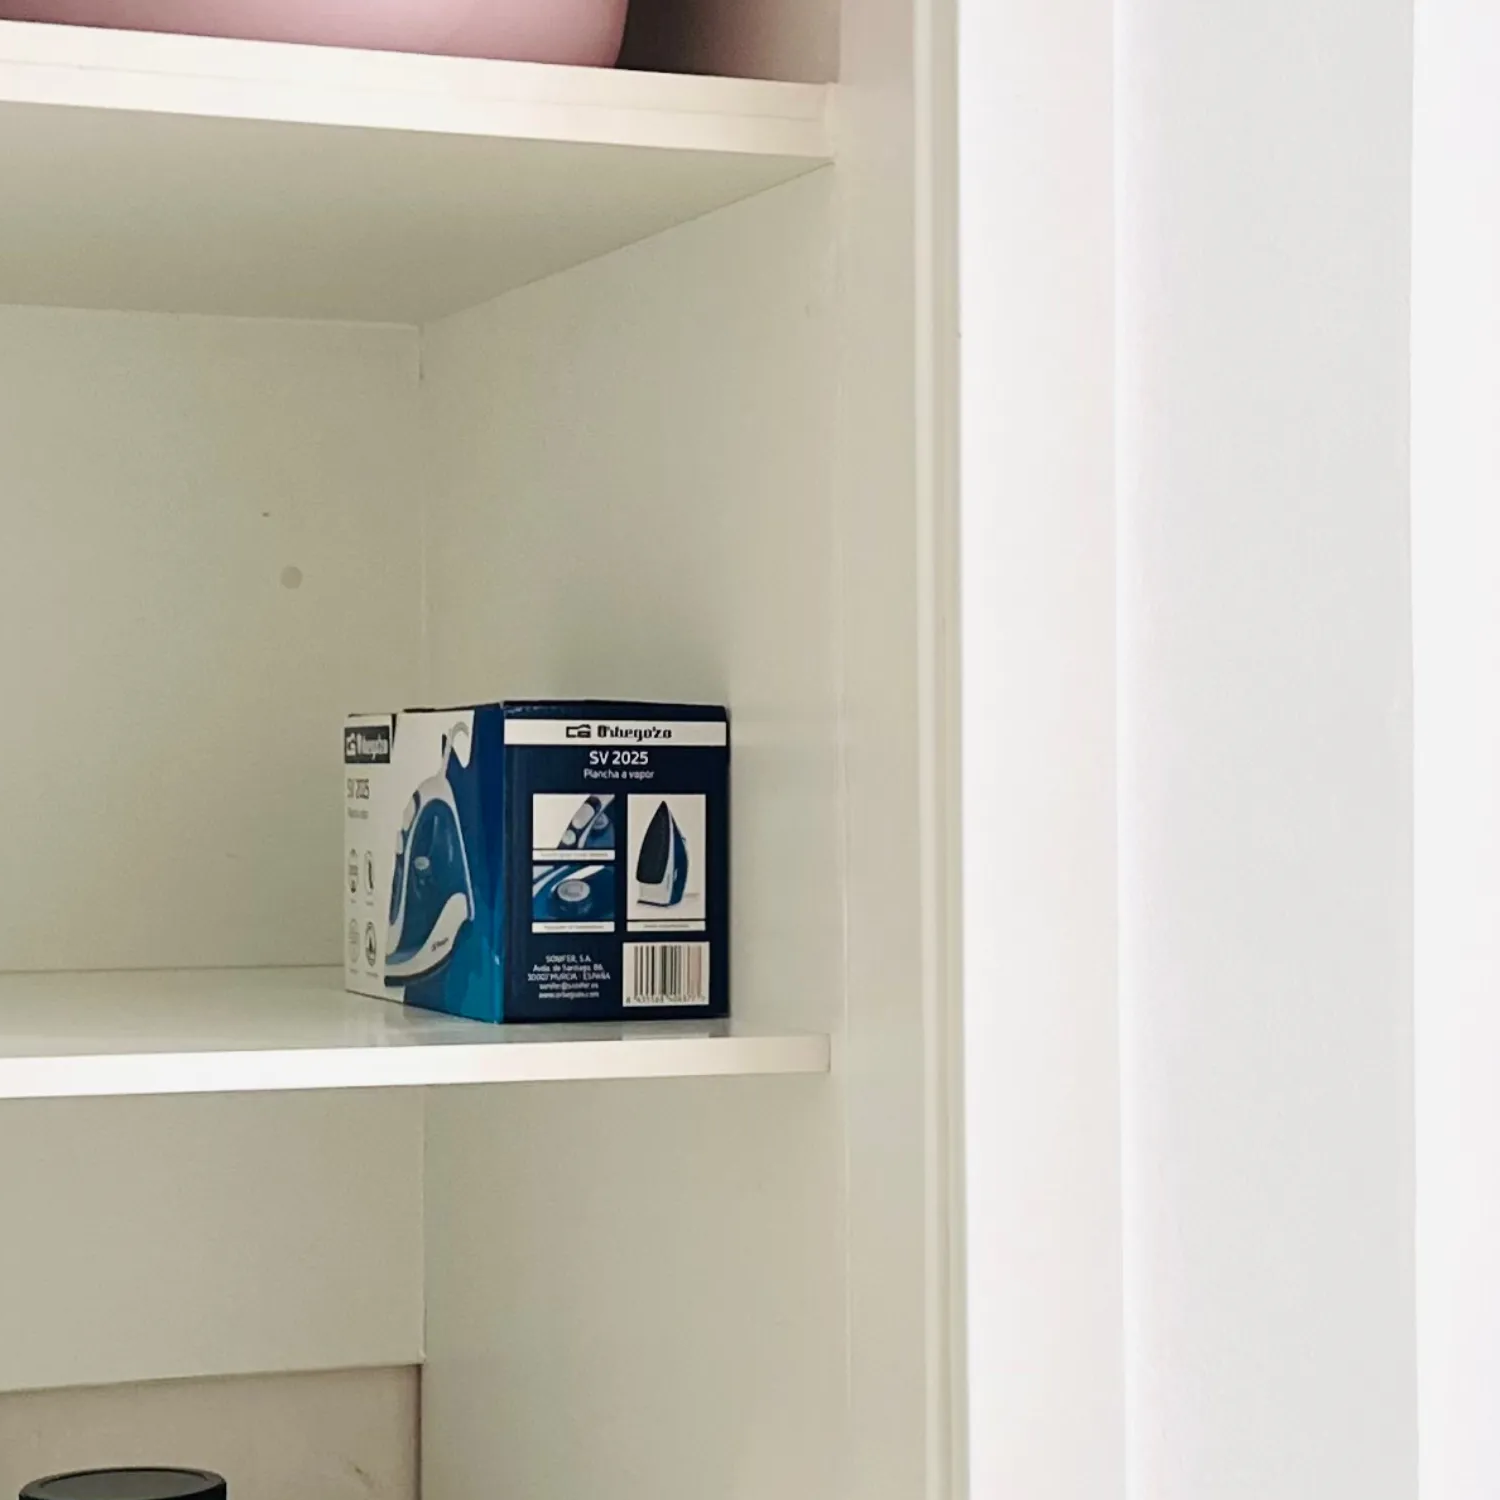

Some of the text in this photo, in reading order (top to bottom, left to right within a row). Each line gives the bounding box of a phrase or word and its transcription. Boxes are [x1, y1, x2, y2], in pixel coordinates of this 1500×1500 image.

[589, 750, 649, 765] SV 2025
[583, 768, 654, 780] Plancha a vapor
